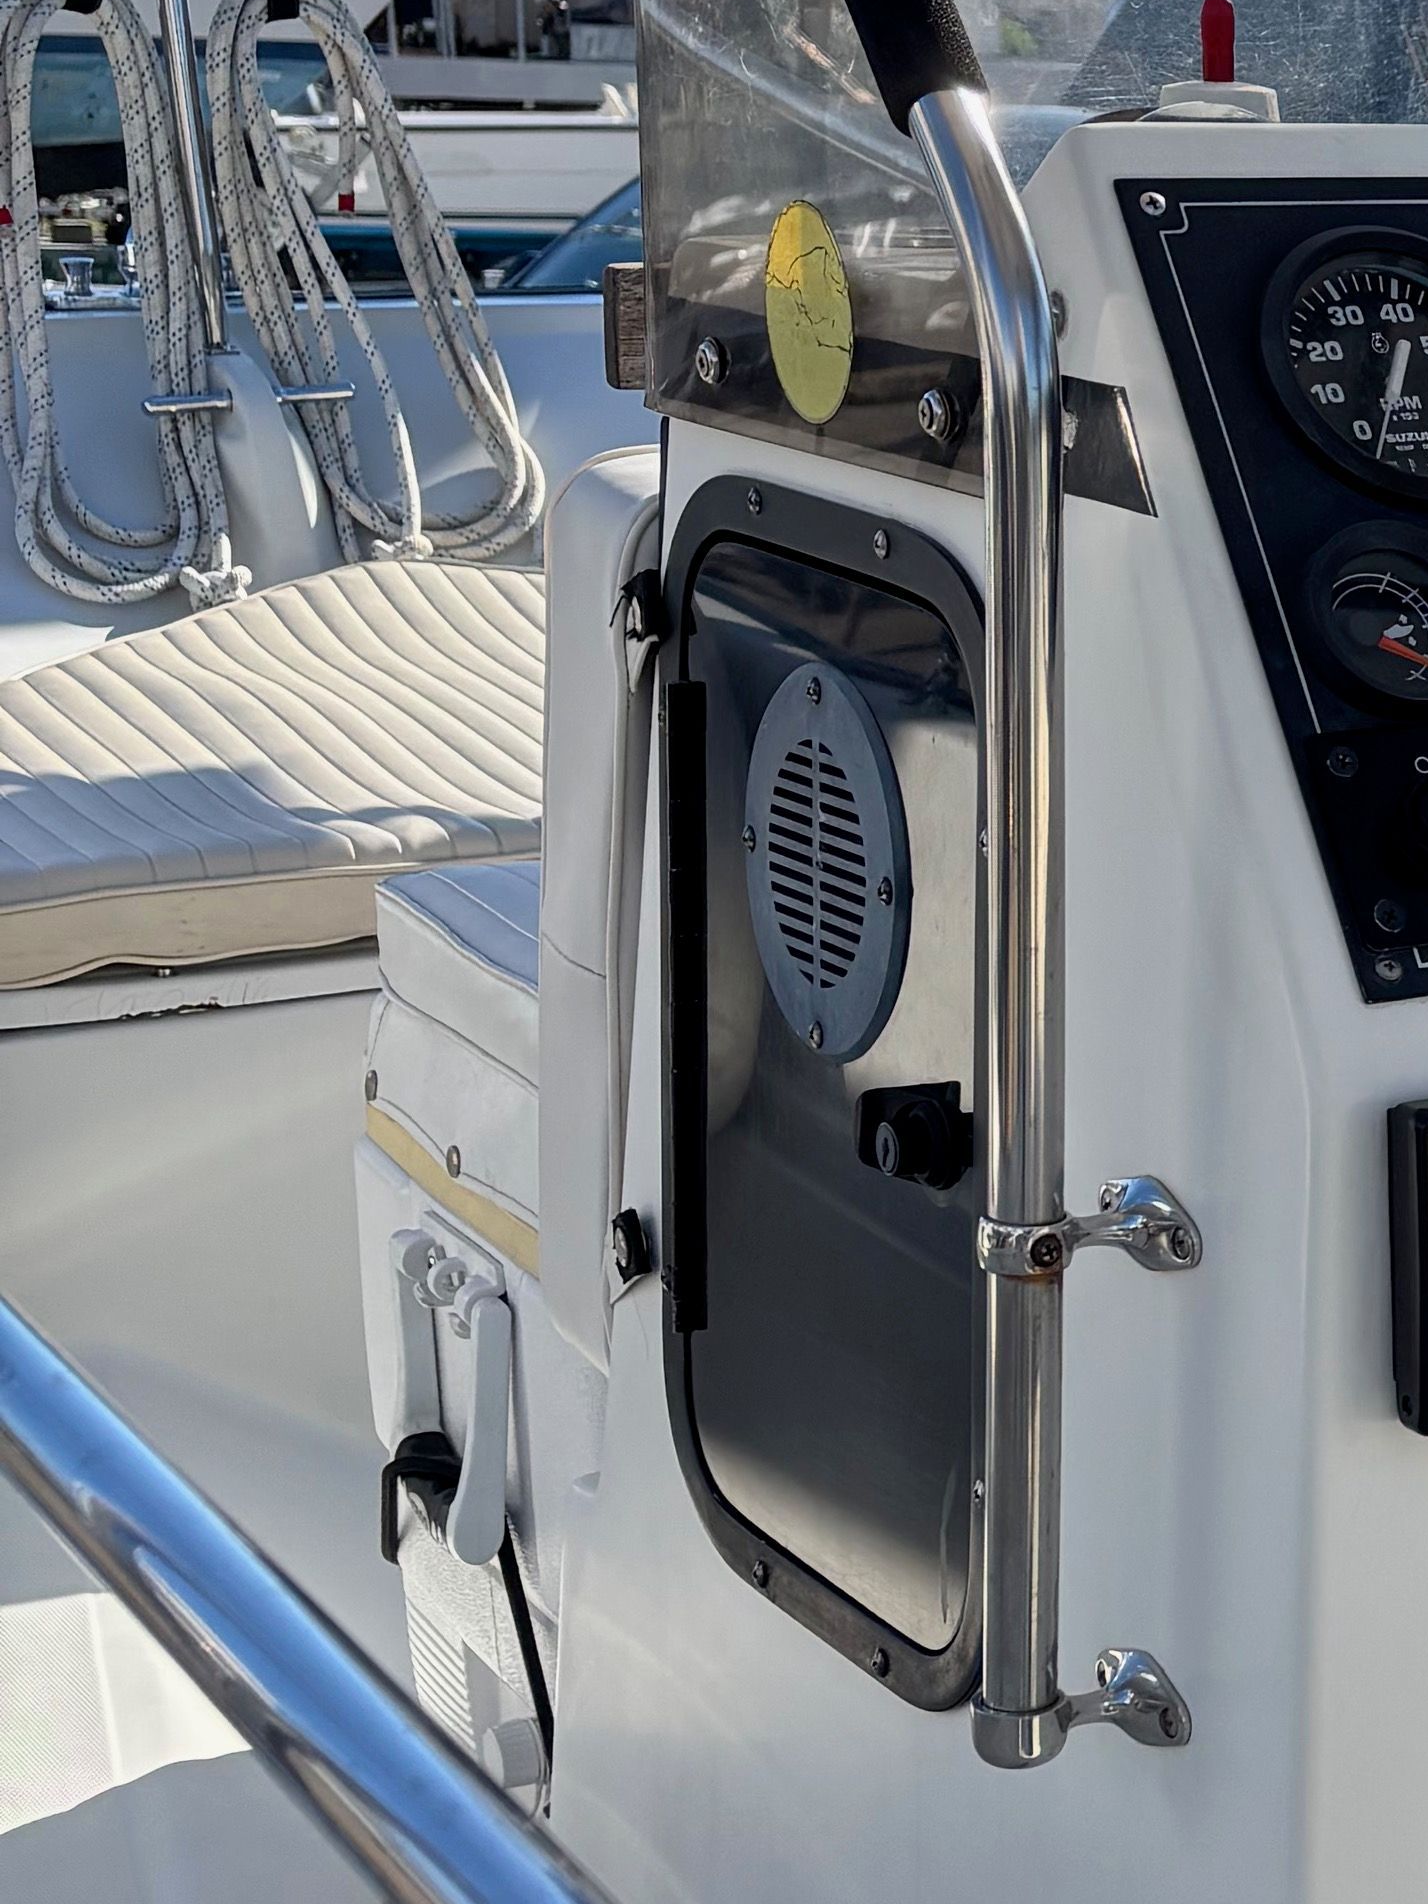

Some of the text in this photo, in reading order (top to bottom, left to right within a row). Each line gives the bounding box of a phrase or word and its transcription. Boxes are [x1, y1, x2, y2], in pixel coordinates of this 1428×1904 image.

[1327, 305, 1364, 326] 30
[1379, 303, 1415, 323] 40
[1306, 341, 1344, 362] 20
[1310, 383, 1345, 404] 10
[1353, 420, 1372, 440] 0
